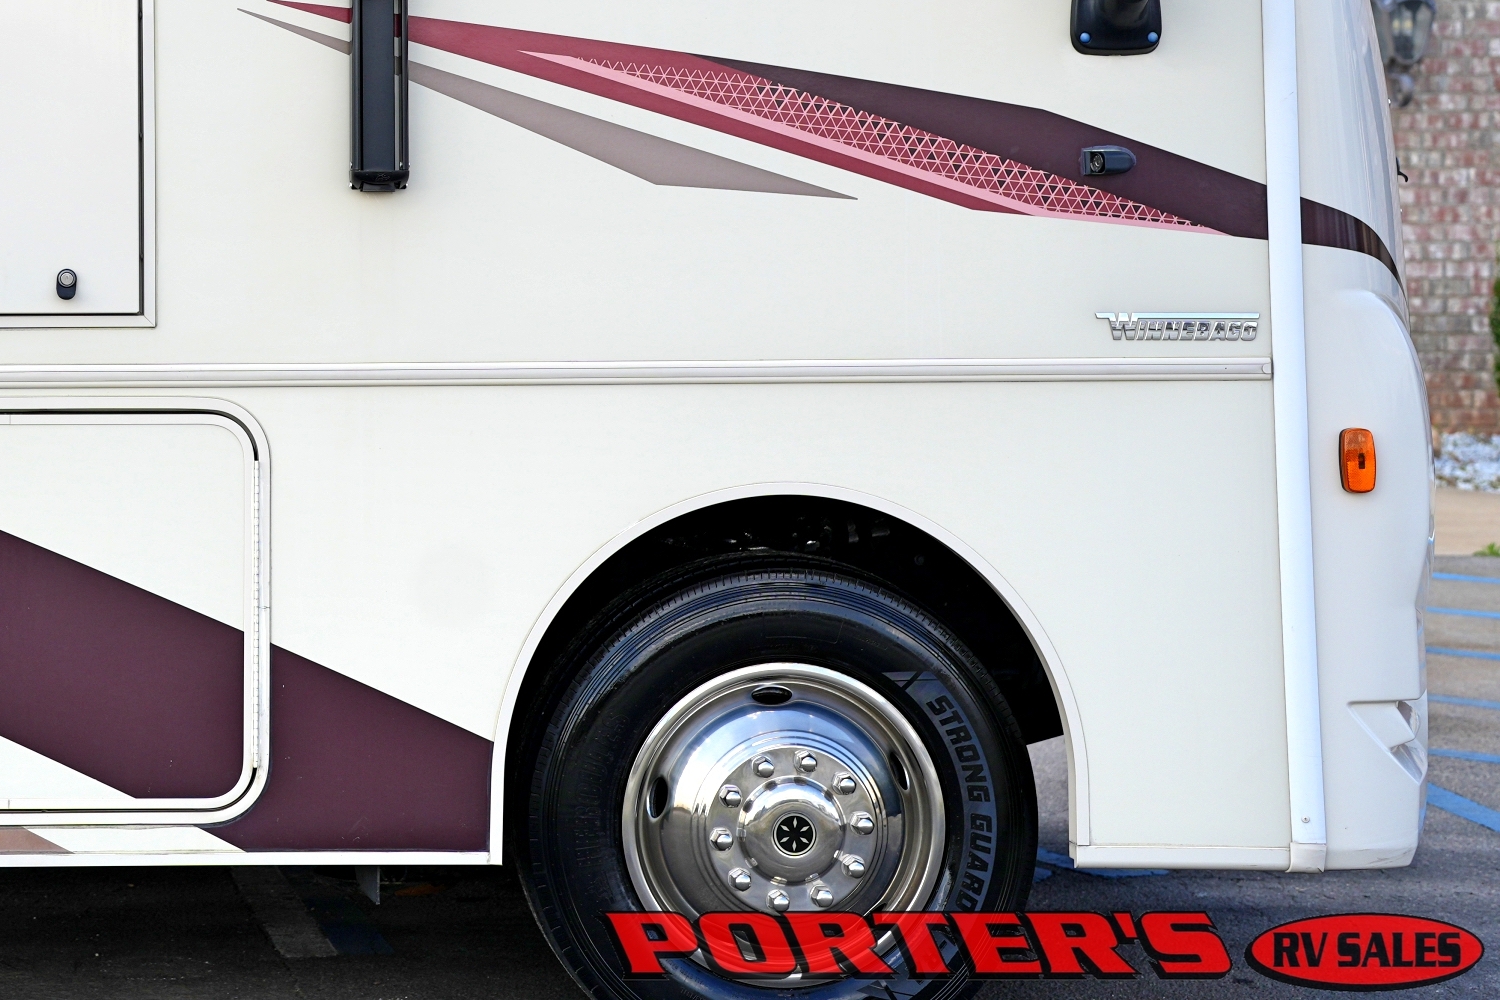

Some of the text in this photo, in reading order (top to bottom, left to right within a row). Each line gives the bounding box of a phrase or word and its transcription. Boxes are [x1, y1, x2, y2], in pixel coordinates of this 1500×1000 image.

[1096, 312, 1259, 341] WINNEBAGO
[925, 694, 991, 803] STRONG
[954, 812, 993, 912] GUARD
